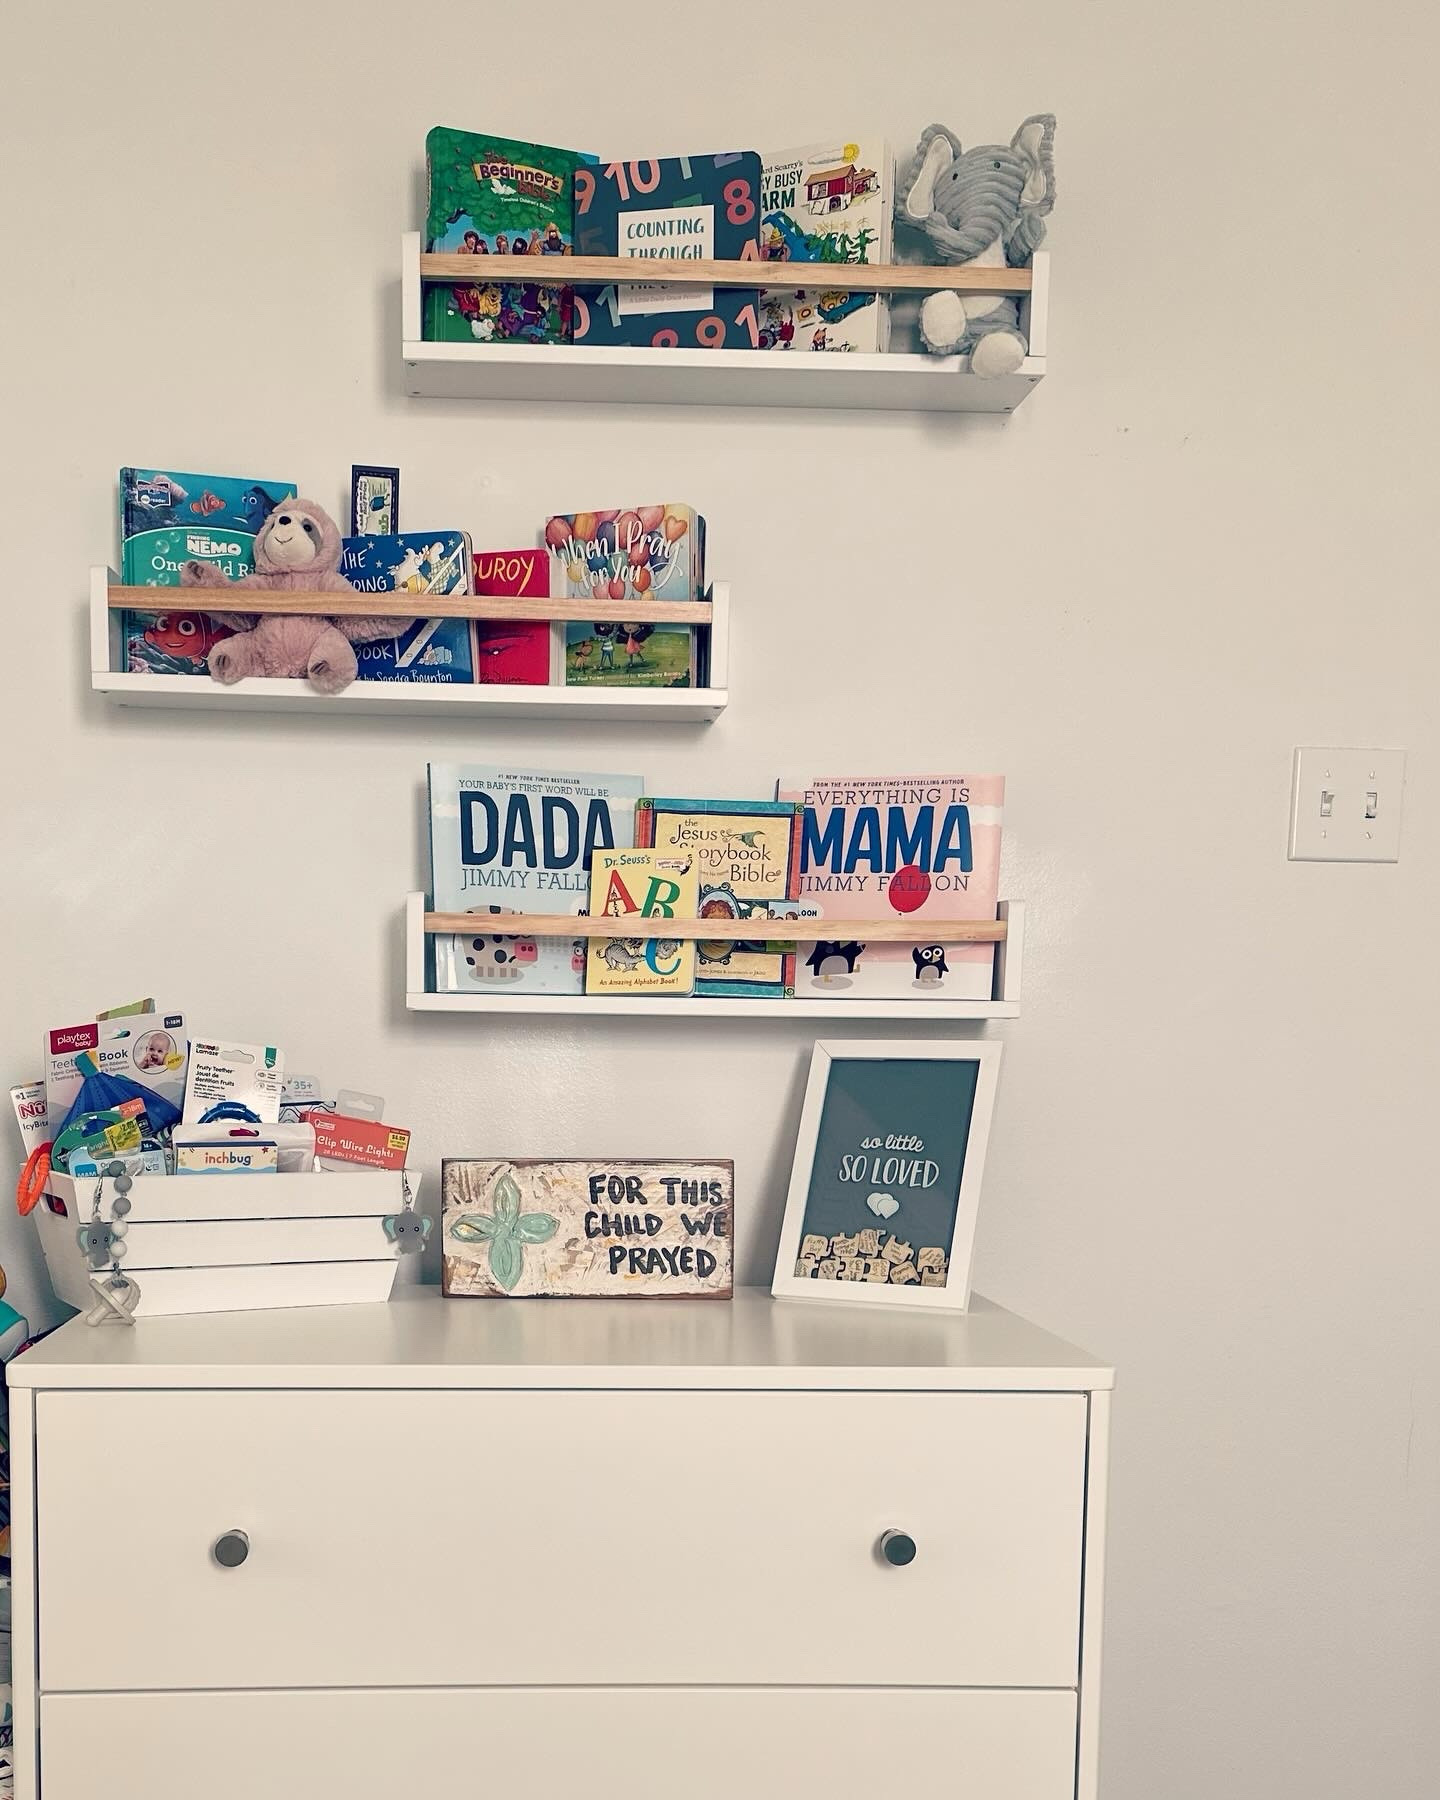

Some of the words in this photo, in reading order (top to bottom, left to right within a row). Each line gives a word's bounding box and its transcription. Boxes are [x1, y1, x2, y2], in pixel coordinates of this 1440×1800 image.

[479, 164, 560, 191] Beginner's
[773, 160, 804, 172] Scarry's
[603, 159, 660, 201] 10
[774, 169, 803, 188] BUSY
[575, 170, 596, 215] 9
[723, 179, 756, 225] 8
[762, 187, 796, 212] ARM
[627, 217, 705, 240] COUNTING
[186, 539, 242, 556] NEMO
[342, 546, 368, 570] THE
[551, 534, 609, 568] When
[612, 521, 622, 555] I
[627, 519, 684, 591] Pray
[151, 555, 184, 572] One
[581, 564, 610, 591] for
[611, 556, 643, 584] You
[343, 573, 388, 592] OING
[376, 671, 410, 682] Sandra
[410, 669, 453, 683] Boynton
[458, 779, 485, 790] YOUR
[486, 780, 517, 791] BABY'S
[518, 783, 543, 793] FIRST
[544, 784, 573, 795] WORD
[574, 786, 597, 797] WILL
[597, 788, 609, 798] BE
[804, 788, 942, 806] EVERYTHING
[950, 788, 970, 803] IS
[459, 791, 616, 871] DADA
[684, 818, 698, 827] the
[669, 824, 719, 845] Jesus
[800, 804, 974, 874] MAMA
[604, 857, 619, 868] Dr.
[620, 854, 651, 866] Seuss's
[680, 842, 772, 867] orybook
[460, 868, 530, 891] JIMMY
[729, 863, 782, 883] Bible
[798, 875, 875, 896] JIMMY
[876, 873, 971, 892] FALLON
[601, 869, 642, 918] A
[640, 876, 681, 919] B
[608, 978, 632, 987] Amazing
[633, 977, 659, 986] Alphabet
[659, 977, 679, 985] Book!
[57, 1031, 91, 1046] playtex
[99, 1049, 129, 1062] Book
[195, 1048, 219, 1057] Lamaze
[293, 1080, 313, 1090] 35+
[316, 1135, 337, 1149] Clip
[339, 1138, 363, 1152] Wire
[365, 1143, 394, 1159] Lights
[860, 1136, 883, 1150] so
[885, 1134, 924, 1153] little
[204, 1151, 252, 1166] inchbug
[839, 1154, 867, 1183] SO
[871, 1156, 940, 1189] LOVED
[588, 1173, 648, 1205] FOR
[659, 1177, 723, 1207] THIS
[584, 1211, 664, 1239] CHILD
[680, 1211, 728, 1238] WE
[608, 1245, 717, 1278] PRAYED
